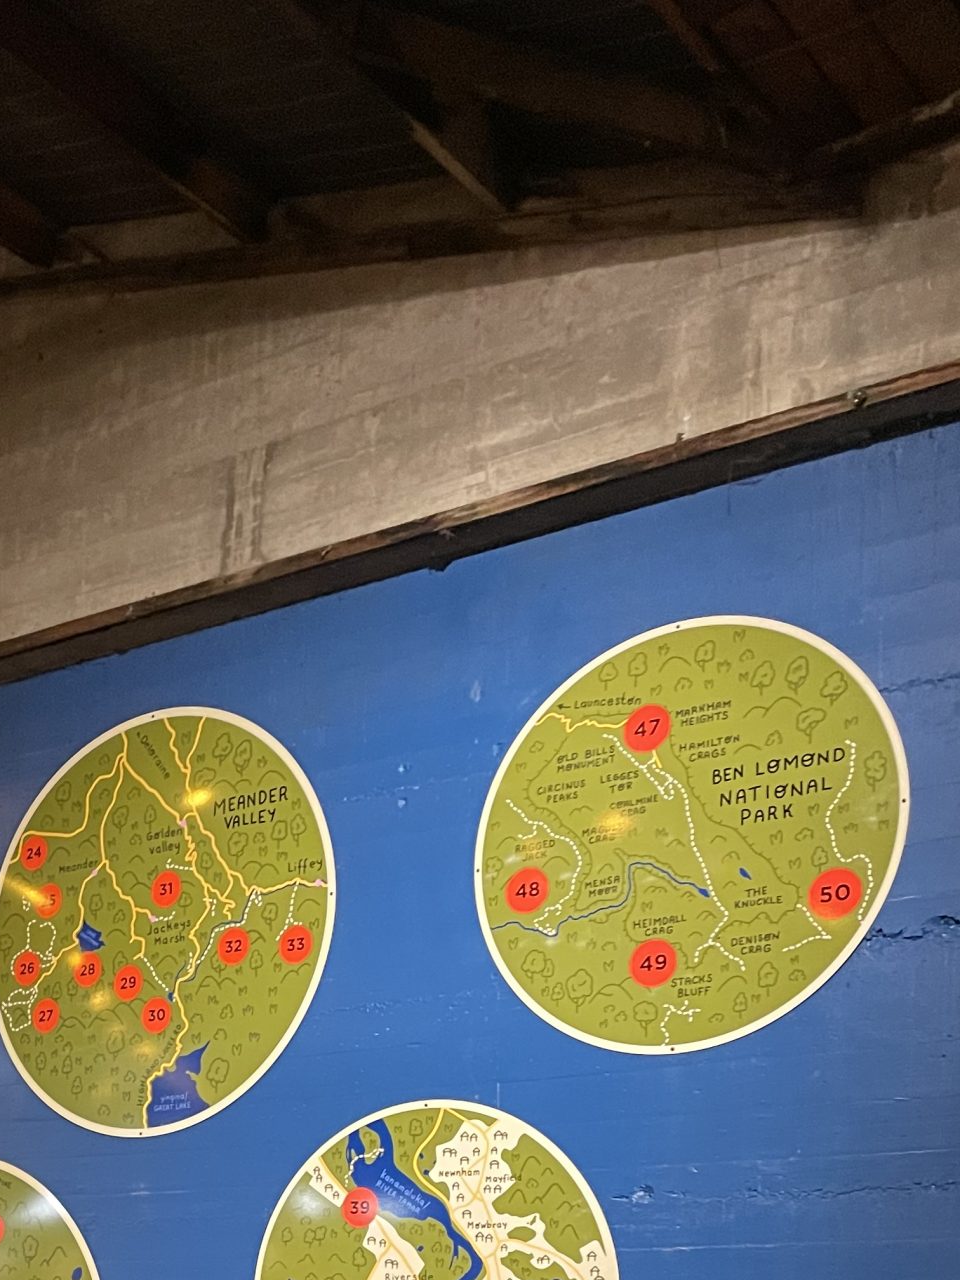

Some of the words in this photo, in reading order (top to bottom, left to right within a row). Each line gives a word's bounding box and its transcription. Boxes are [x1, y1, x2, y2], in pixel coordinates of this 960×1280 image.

[675, 700, 731, 719] MARKHAM
[681, 711, 729, 727] HEIGHTS
[634, 718, 661, 737] 47
[585, 745, 615, 760] BILLS
[688, 747, 727, 762] CRAGS
[712, 764, 744, 785] BEN
[756, 747, 846, 776] LOMOND
[600, 769, 640, 784] LEGGES
[537, 779, 586, 796] CIRCINUS
[719, 777, 833, 807] NATIONAL
[213, 785, 288, 817] MEANDER
[546, 791, 579, 804] PEAKS
[224, 808, 277, 830] VALLEY
[740, 803, 794, 826] PARK
[26, 846, 42, 860] 24
[515, 839, 556, 853] RAGGED
[58, 859, 98, 873] Meander
[287, 858, 323, 875] Liffey
[159, 882, 173, 896] 31
[585, 875, 620, 890] MENSA
[515, 882, 540, 899] 48
[745, 886, 768, 897] THE
[820, 884, 851, 903] 50
[734, 895, 784, 910] KNUCKLE
[147, 919, 191, 936] Jackeys
[632, 914, 687, 930] HEIMDALL
[644, 925, 674, 936] CRAG
[153, 932, 185, 946] Marsh
[225, 939, 242, 953] 32
[287, 937, 305, 951] 33
[740, 943, 772, 955] CRAG
[19, 962, 35, 975] 26
[640, 953, 667, 971] 49
[80, 963, 95, 977] 28
[120, 976, 137, 990] 29
[671, 974, 713, 988] STACKS
[677, 986, 711, 998] BLUFF
[38, 1009, 54, 1023] 27
[148, 1008, 166, 1022] 30
[438, 1168, 480, 1177] Newnham
[485, 1173, 522, 1186] Mayfield
[350, 1201, 370, 1215] 39
